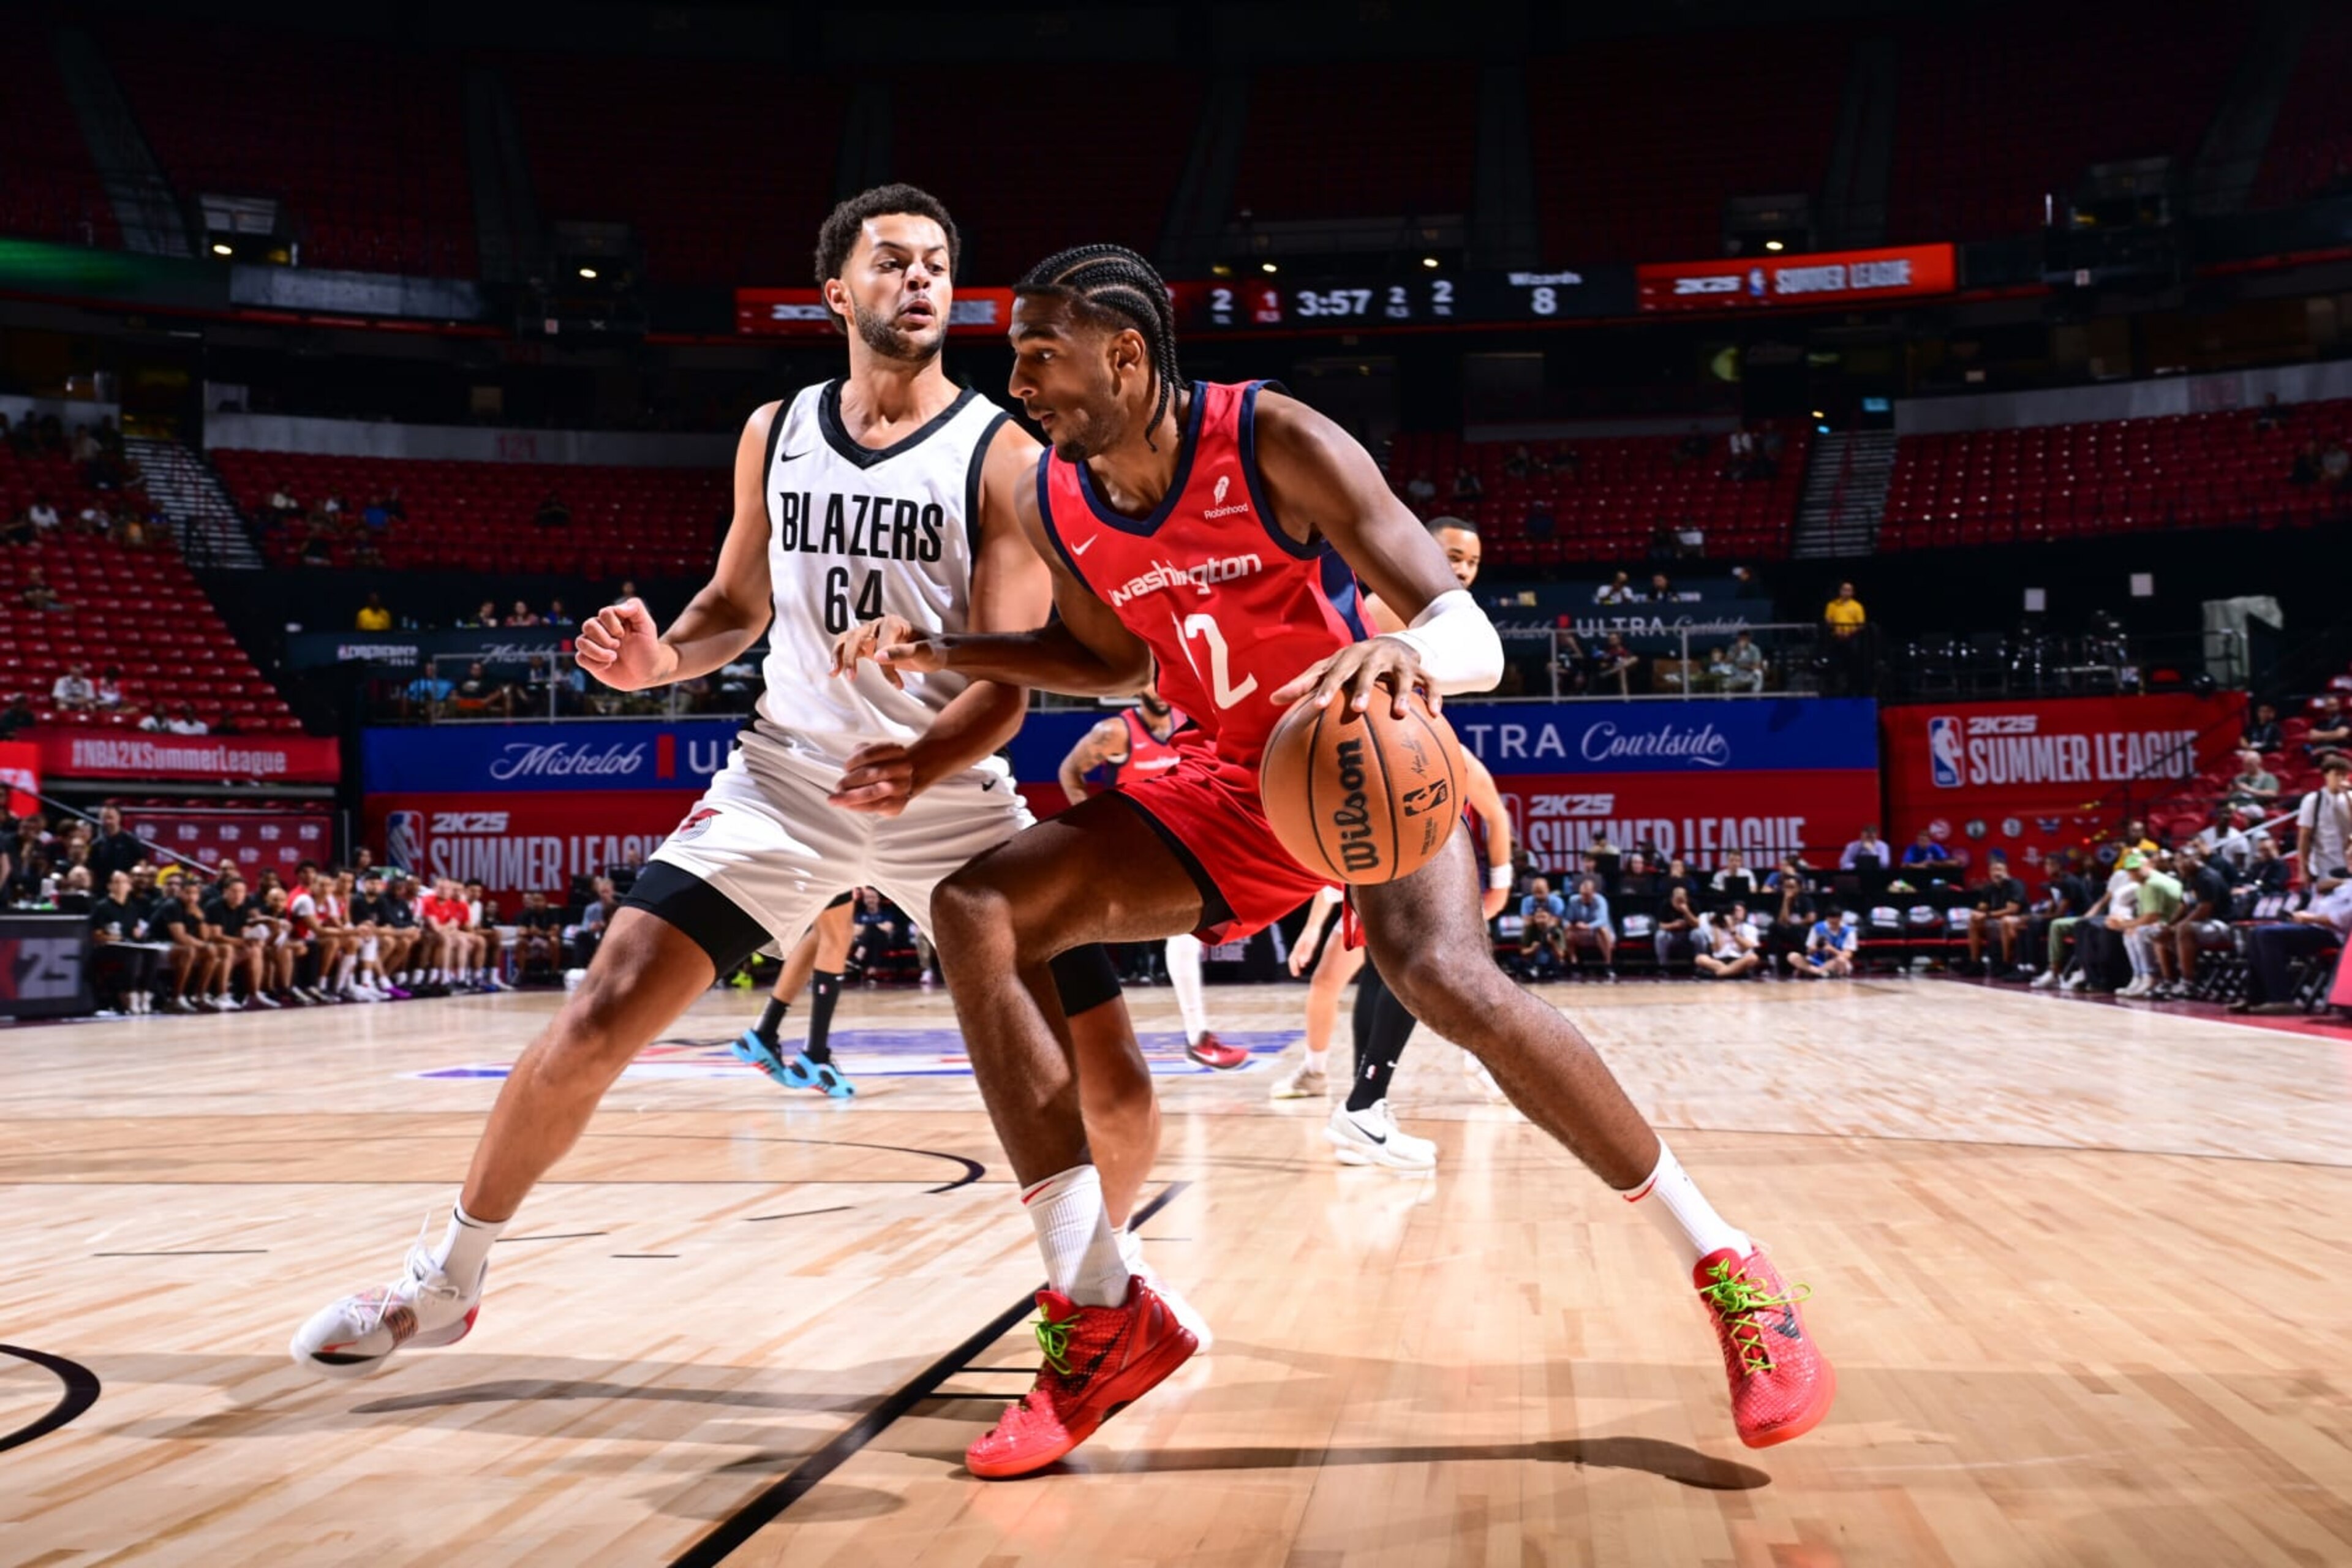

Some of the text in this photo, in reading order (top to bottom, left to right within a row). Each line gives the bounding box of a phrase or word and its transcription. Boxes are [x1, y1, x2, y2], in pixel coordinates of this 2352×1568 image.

[1297, 288, 1373, 317] 3:57
[1432, 280, 1453, 303] 2
[1532, 287, 1558, 315] 8
[779, 492, 944, 563] BLAZERS
[1204, 502, 1249, 520] Robinhood
[824, 567, 884, 635] 64
[1968, 715, 2038, 734] 2K25
[72, 739, 287, 775] #NBA2KSummerLeague
[490, 743, 647, 780] Michelob
[1580, 721, 1730, 766] Courtside
[1968, 730, 2199, 785] SUMMER LEAGUE
[1333, 737, 1379, 872] Wilson
[1529, 794, 1615, 816] 2K25
[431, 812, 510, 834] 2K25
[1530, 816, 1806, 872] SUMMER LEAGUE
[431, 836, 562, 892] SUMMER
